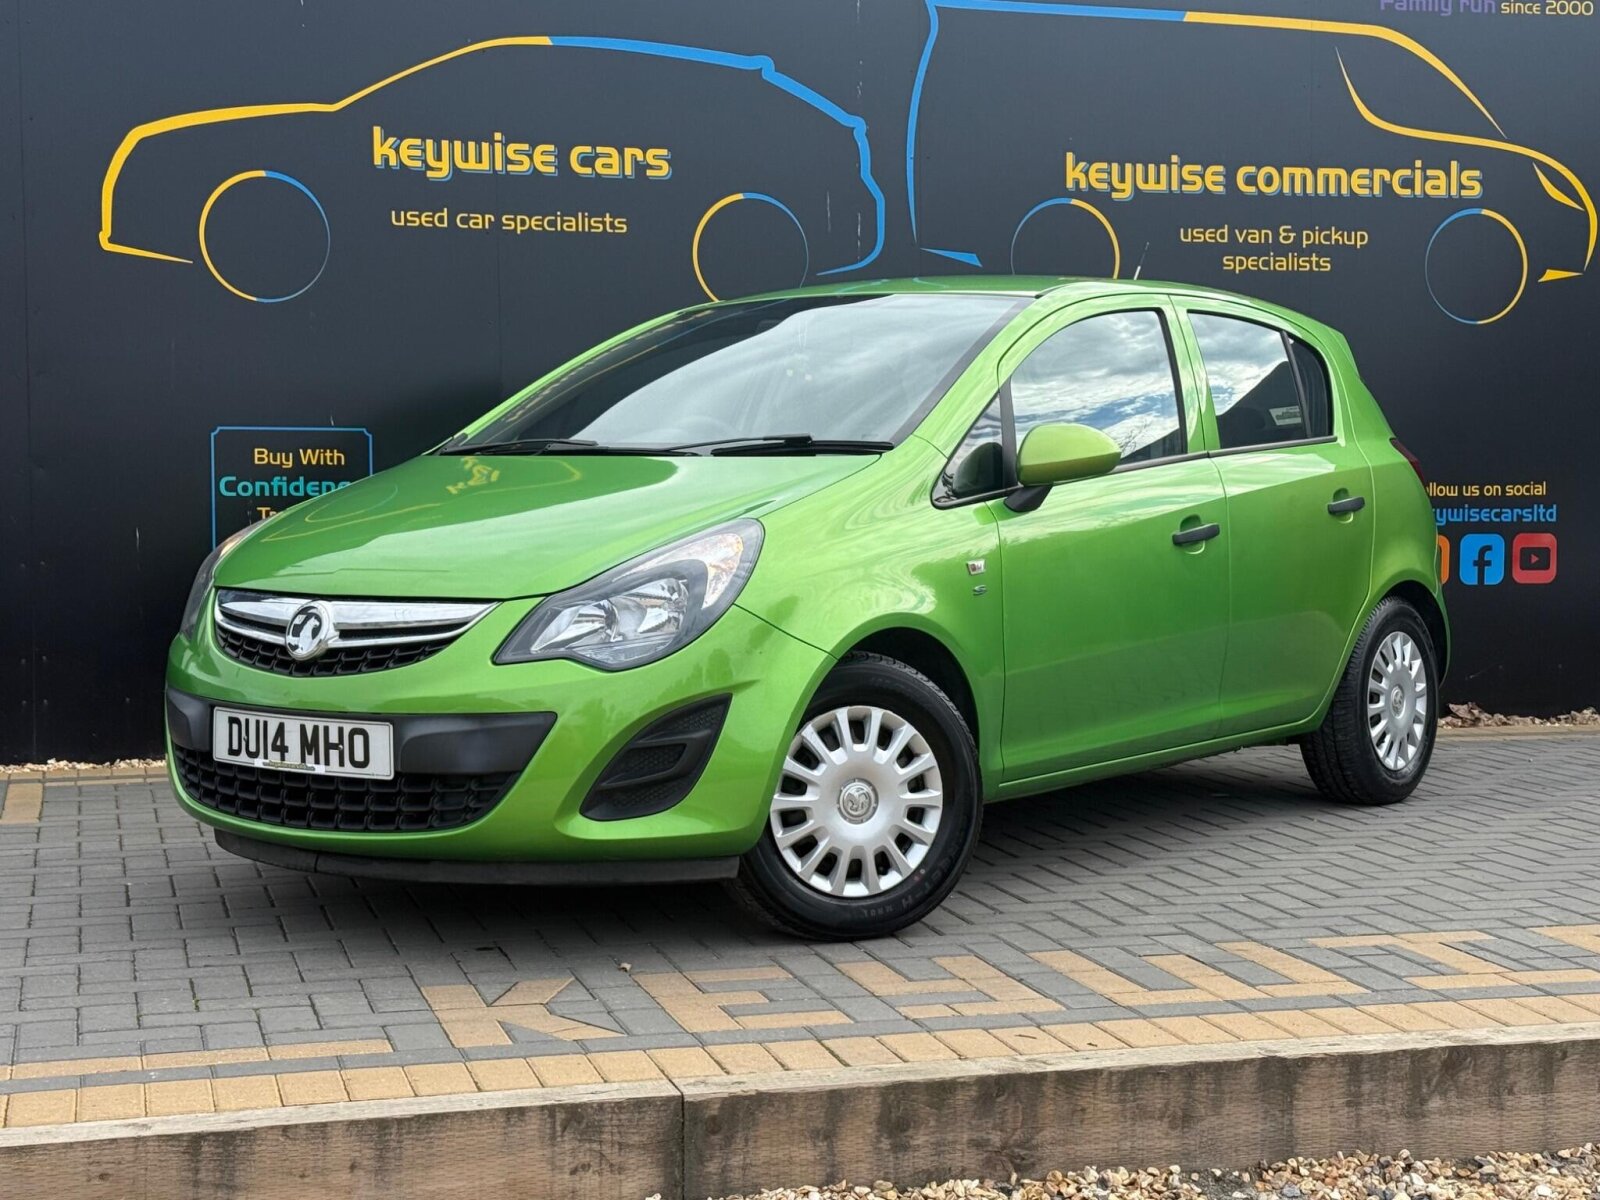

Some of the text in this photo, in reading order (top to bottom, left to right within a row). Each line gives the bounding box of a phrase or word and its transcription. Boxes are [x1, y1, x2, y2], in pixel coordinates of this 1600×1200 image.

[1460, 0, 1496, 13] run
[1501, 0, 1541, 15] since
[1545, 1, 1594, 16] 2000
[372, 126, 673, 181] keywise cars
[1065, 152, 1483, 202] keywise commercials
[391, 207, 628, 235] used car specialists
[1180, 224, 1369, 249] used van & pickup
[1222, 252, 1332, 274] specialists
[253, 447, 346, 469] Buy With
[218, 475, 351, 497] Confiden
[1426, 481, 1547, 497] llow us on social
[1432, 503, 1557, 526] ywisecarsltd
[227, 715, 371, 769] DU14 MHO
[421, 924, 1600, 1049] KEYWI
